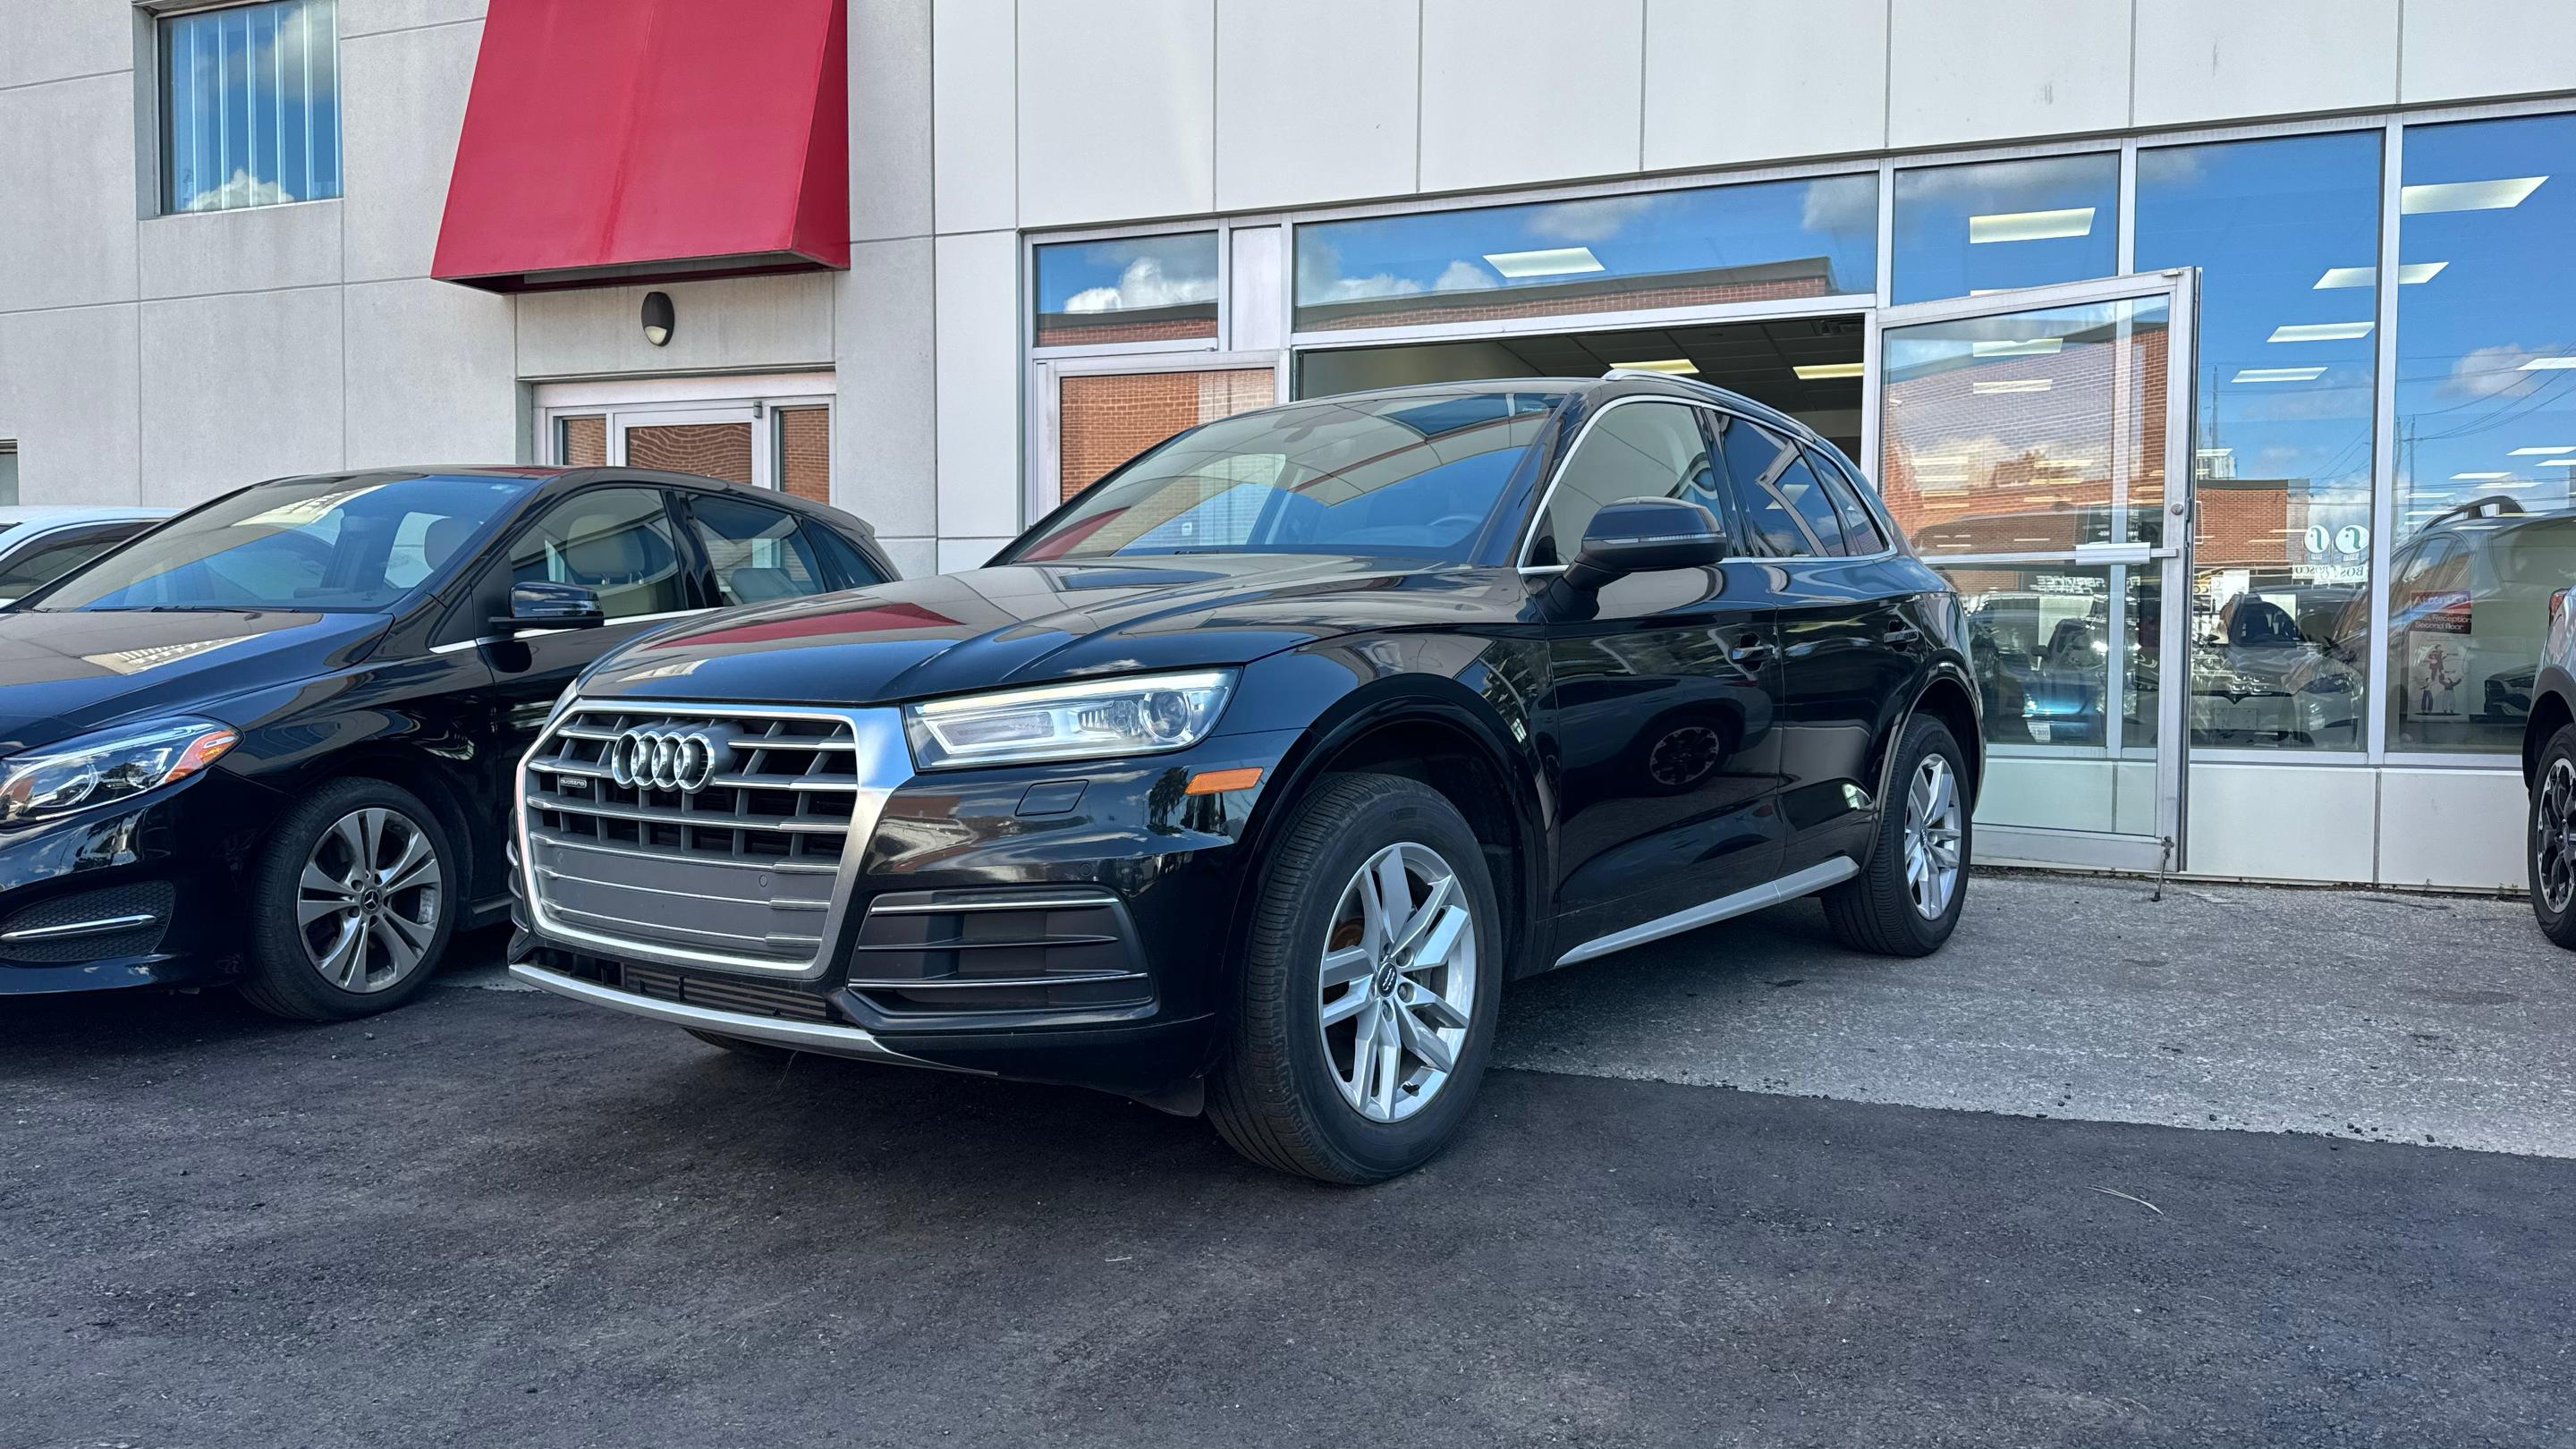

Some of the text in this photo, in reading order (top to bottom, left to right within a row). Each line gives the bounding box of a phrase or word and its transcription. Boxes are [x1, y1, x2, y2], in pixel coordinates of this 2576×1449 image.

[2432, 614, 2472, 623] Reception
[2414, 621, 2462, 631] Second floor
